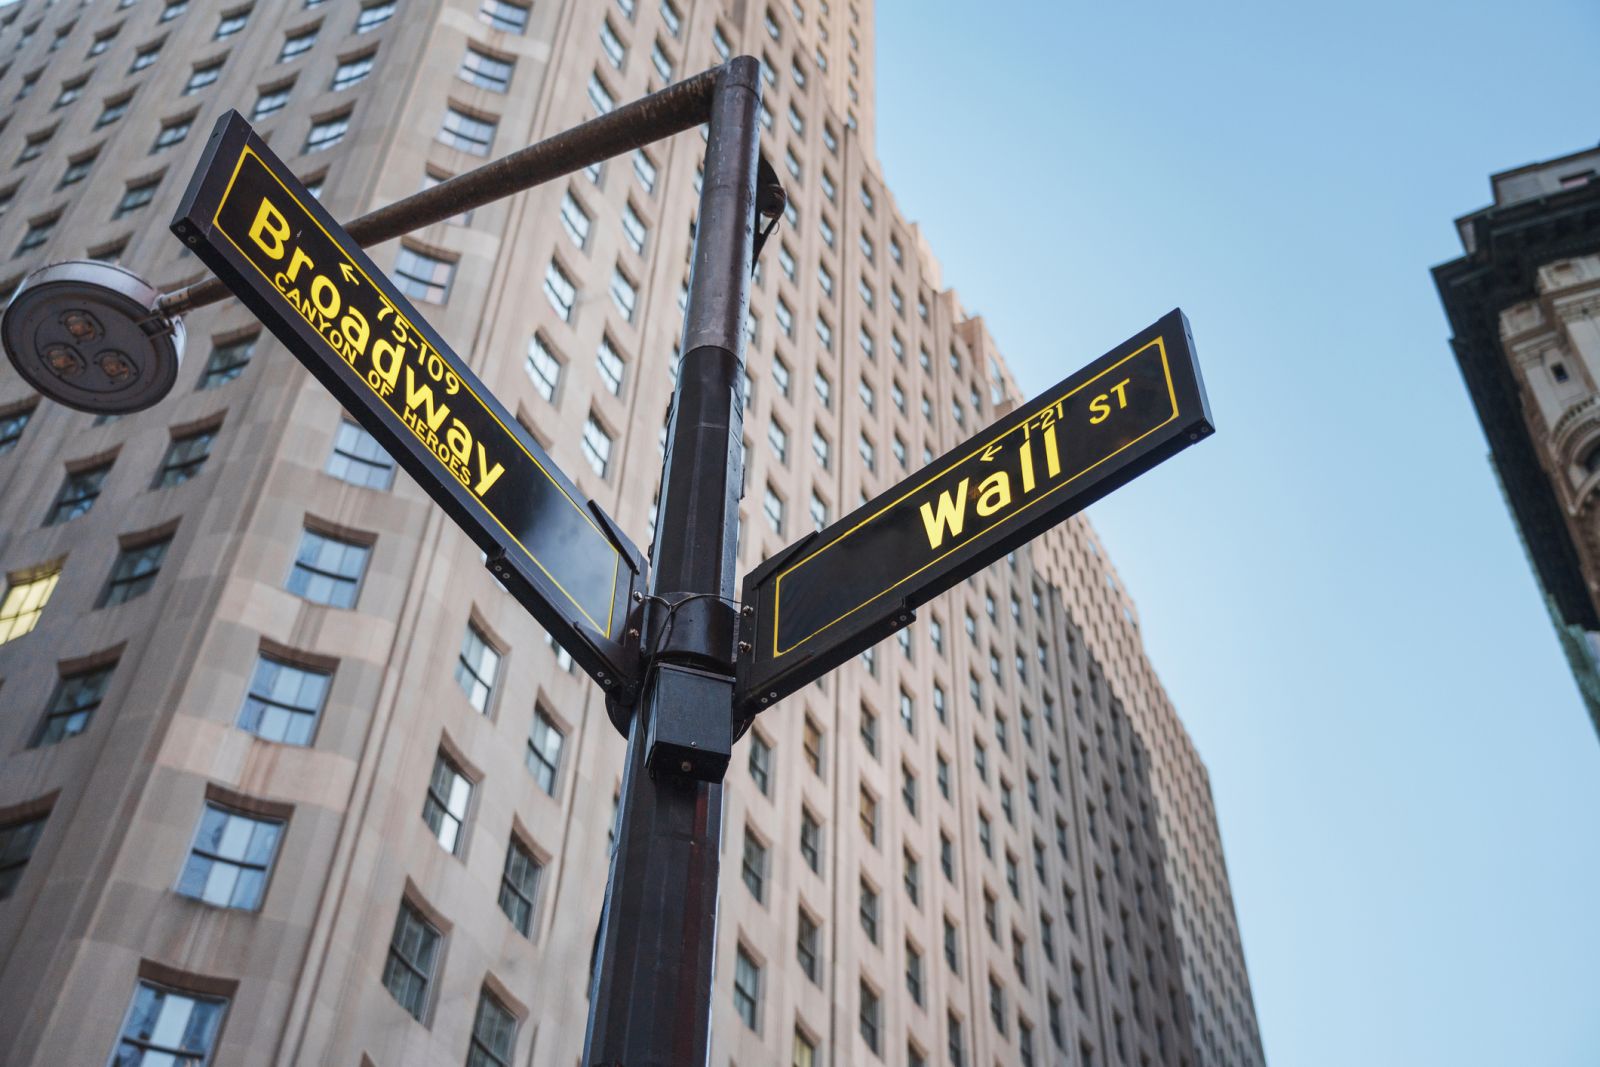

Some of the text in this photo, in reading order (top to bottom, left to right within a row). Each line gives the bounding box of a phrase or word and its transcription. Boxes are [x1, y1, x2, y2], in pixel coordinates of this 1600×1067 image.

[248, 197, 505, 497] Broadway
[275, 273, 472, 485] CANYON OF HEROES
[376, 296, 461, 395] 75-109
[1023, 403, 1064, 441] 1-21
[920, 378, 1130, 549] Wall ST
